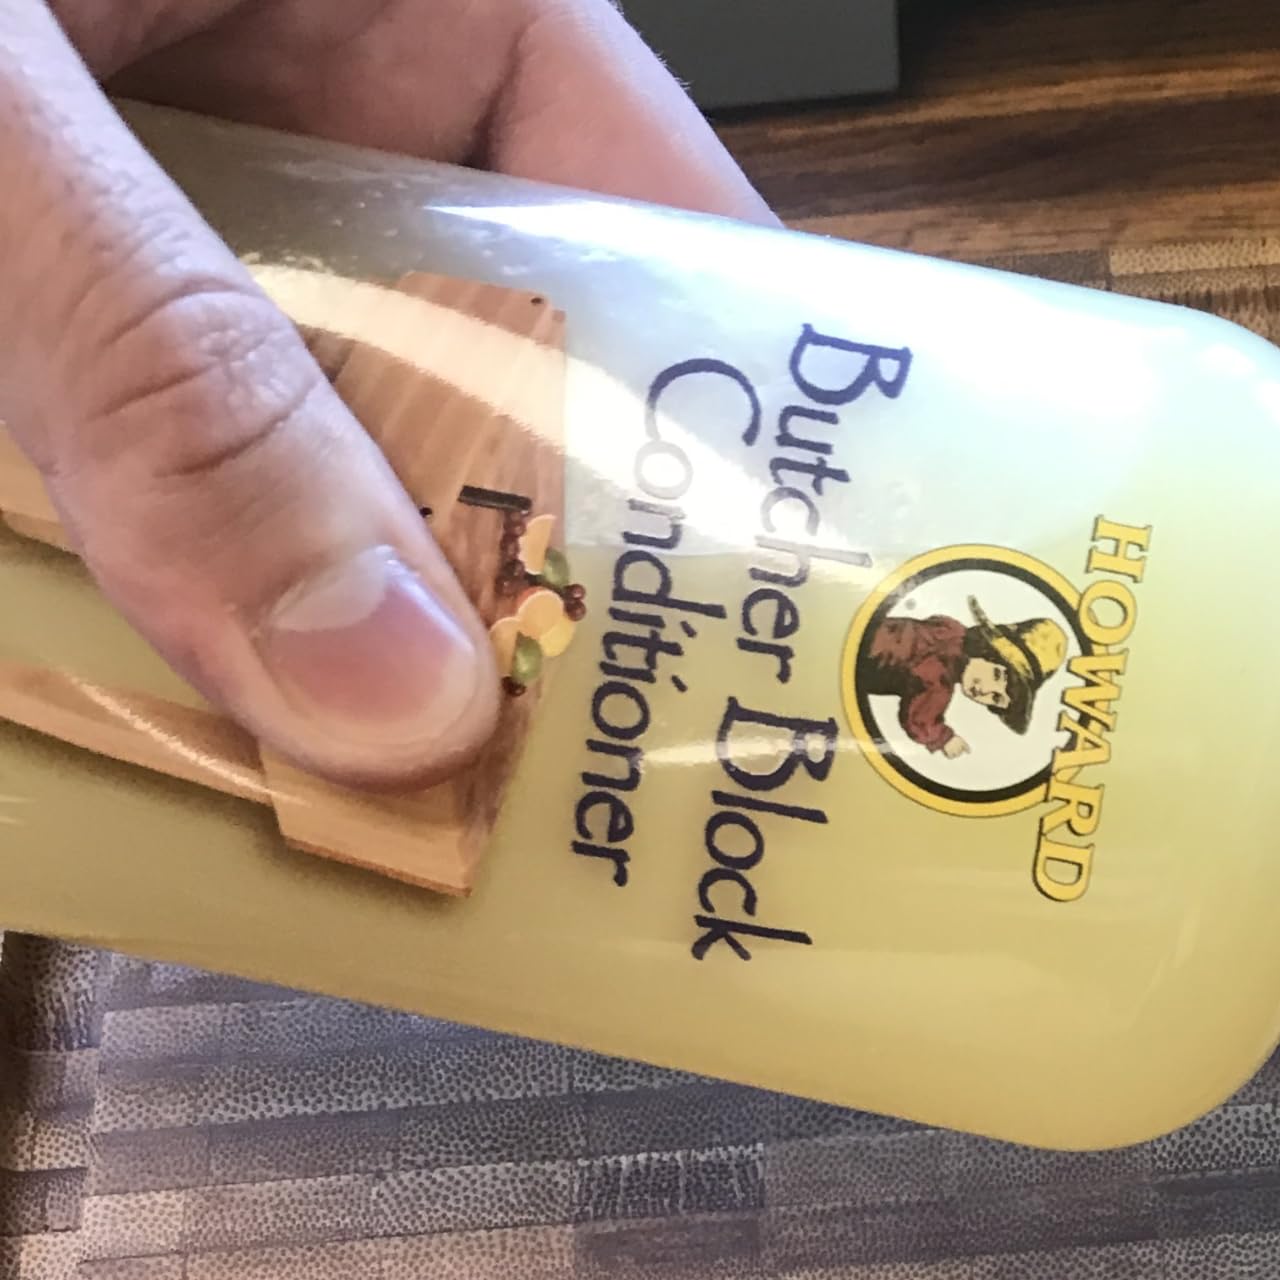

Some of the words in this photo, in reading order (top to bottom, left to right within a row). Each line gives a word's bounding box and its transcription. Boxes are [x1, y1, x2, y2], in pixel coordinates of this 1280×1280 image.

[570, 357, 762, 887] Conditioner
[734, 323, 913, 685] Butcher
[690, 695, 840, 961] Block
[1032, 514, 1154, 902] HOWARD
